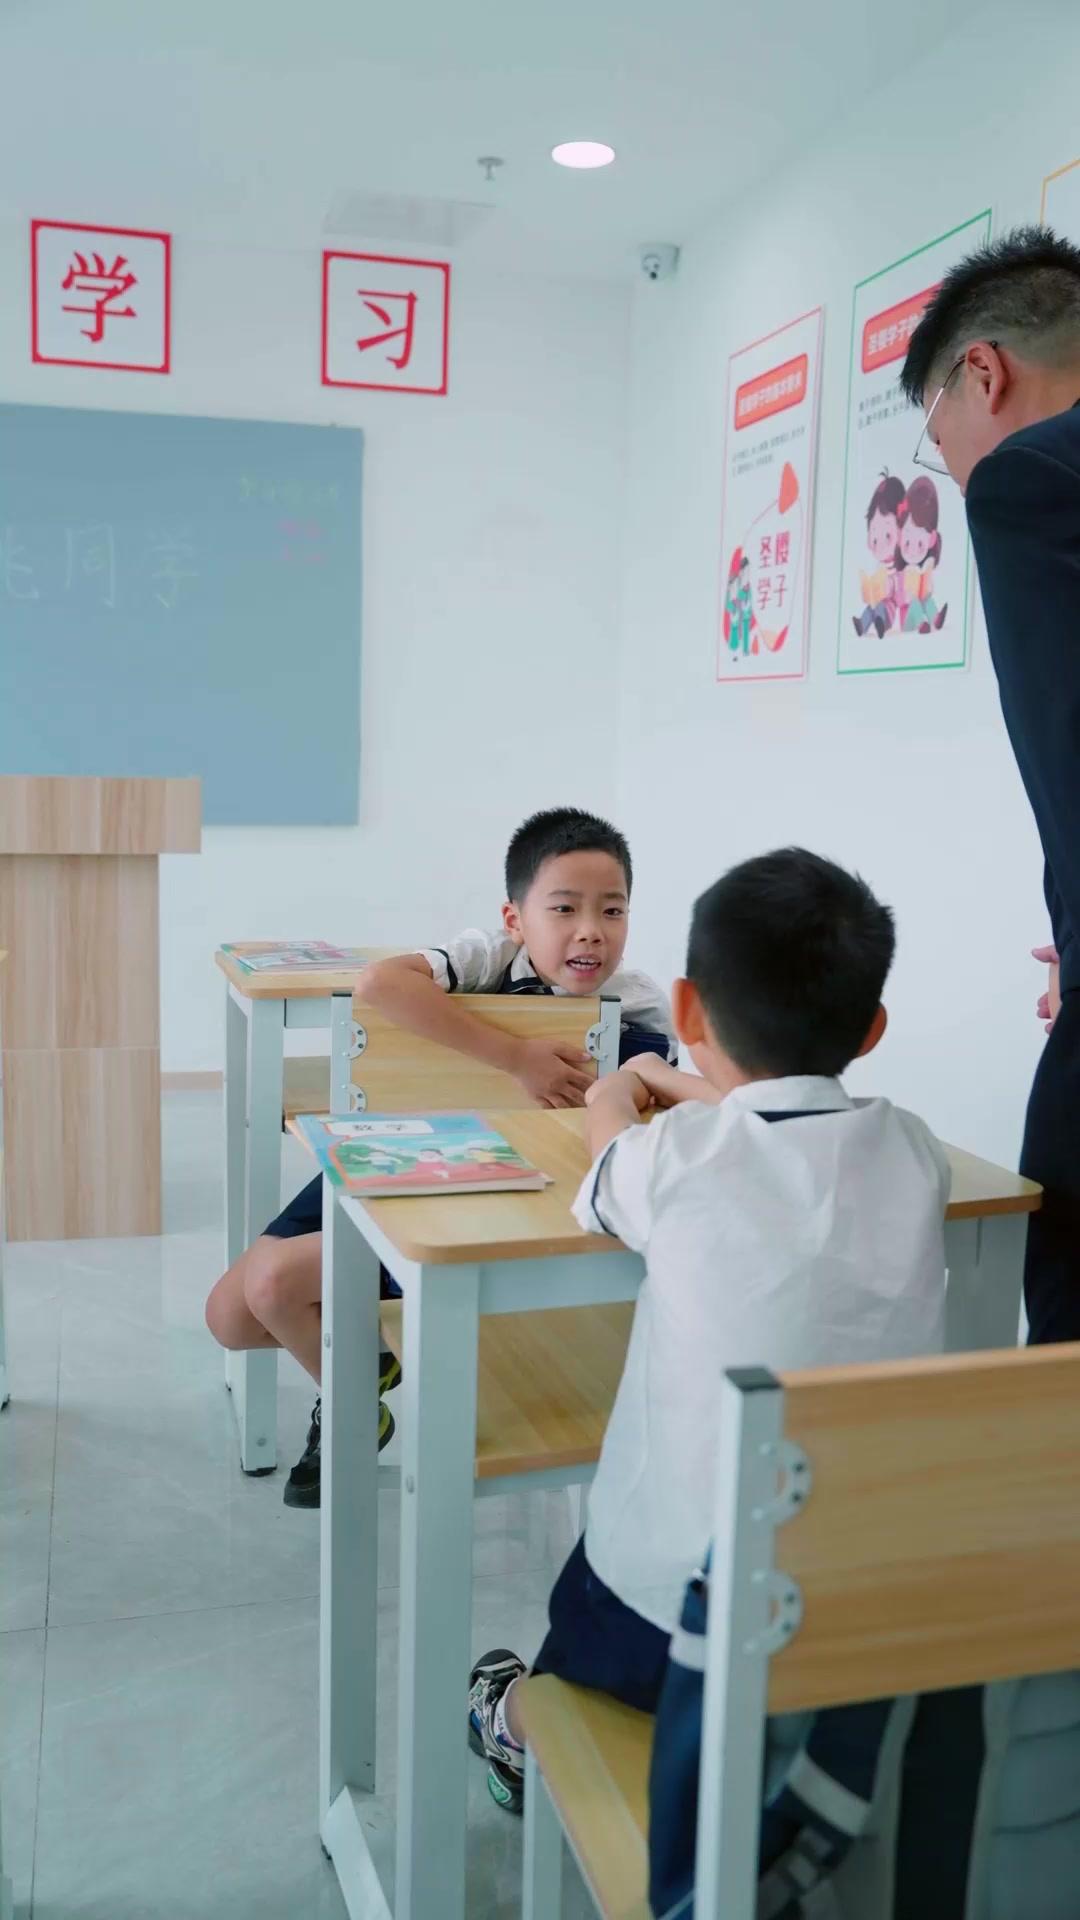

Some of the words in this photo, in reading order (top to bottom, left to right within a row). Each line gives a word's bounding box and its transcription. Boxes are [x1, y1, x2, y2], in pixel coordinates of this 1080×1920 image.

[61, 250, 138, 343] 学
[356, 289, 418, 369] 习
[757, 574, 788, 611] 学子
